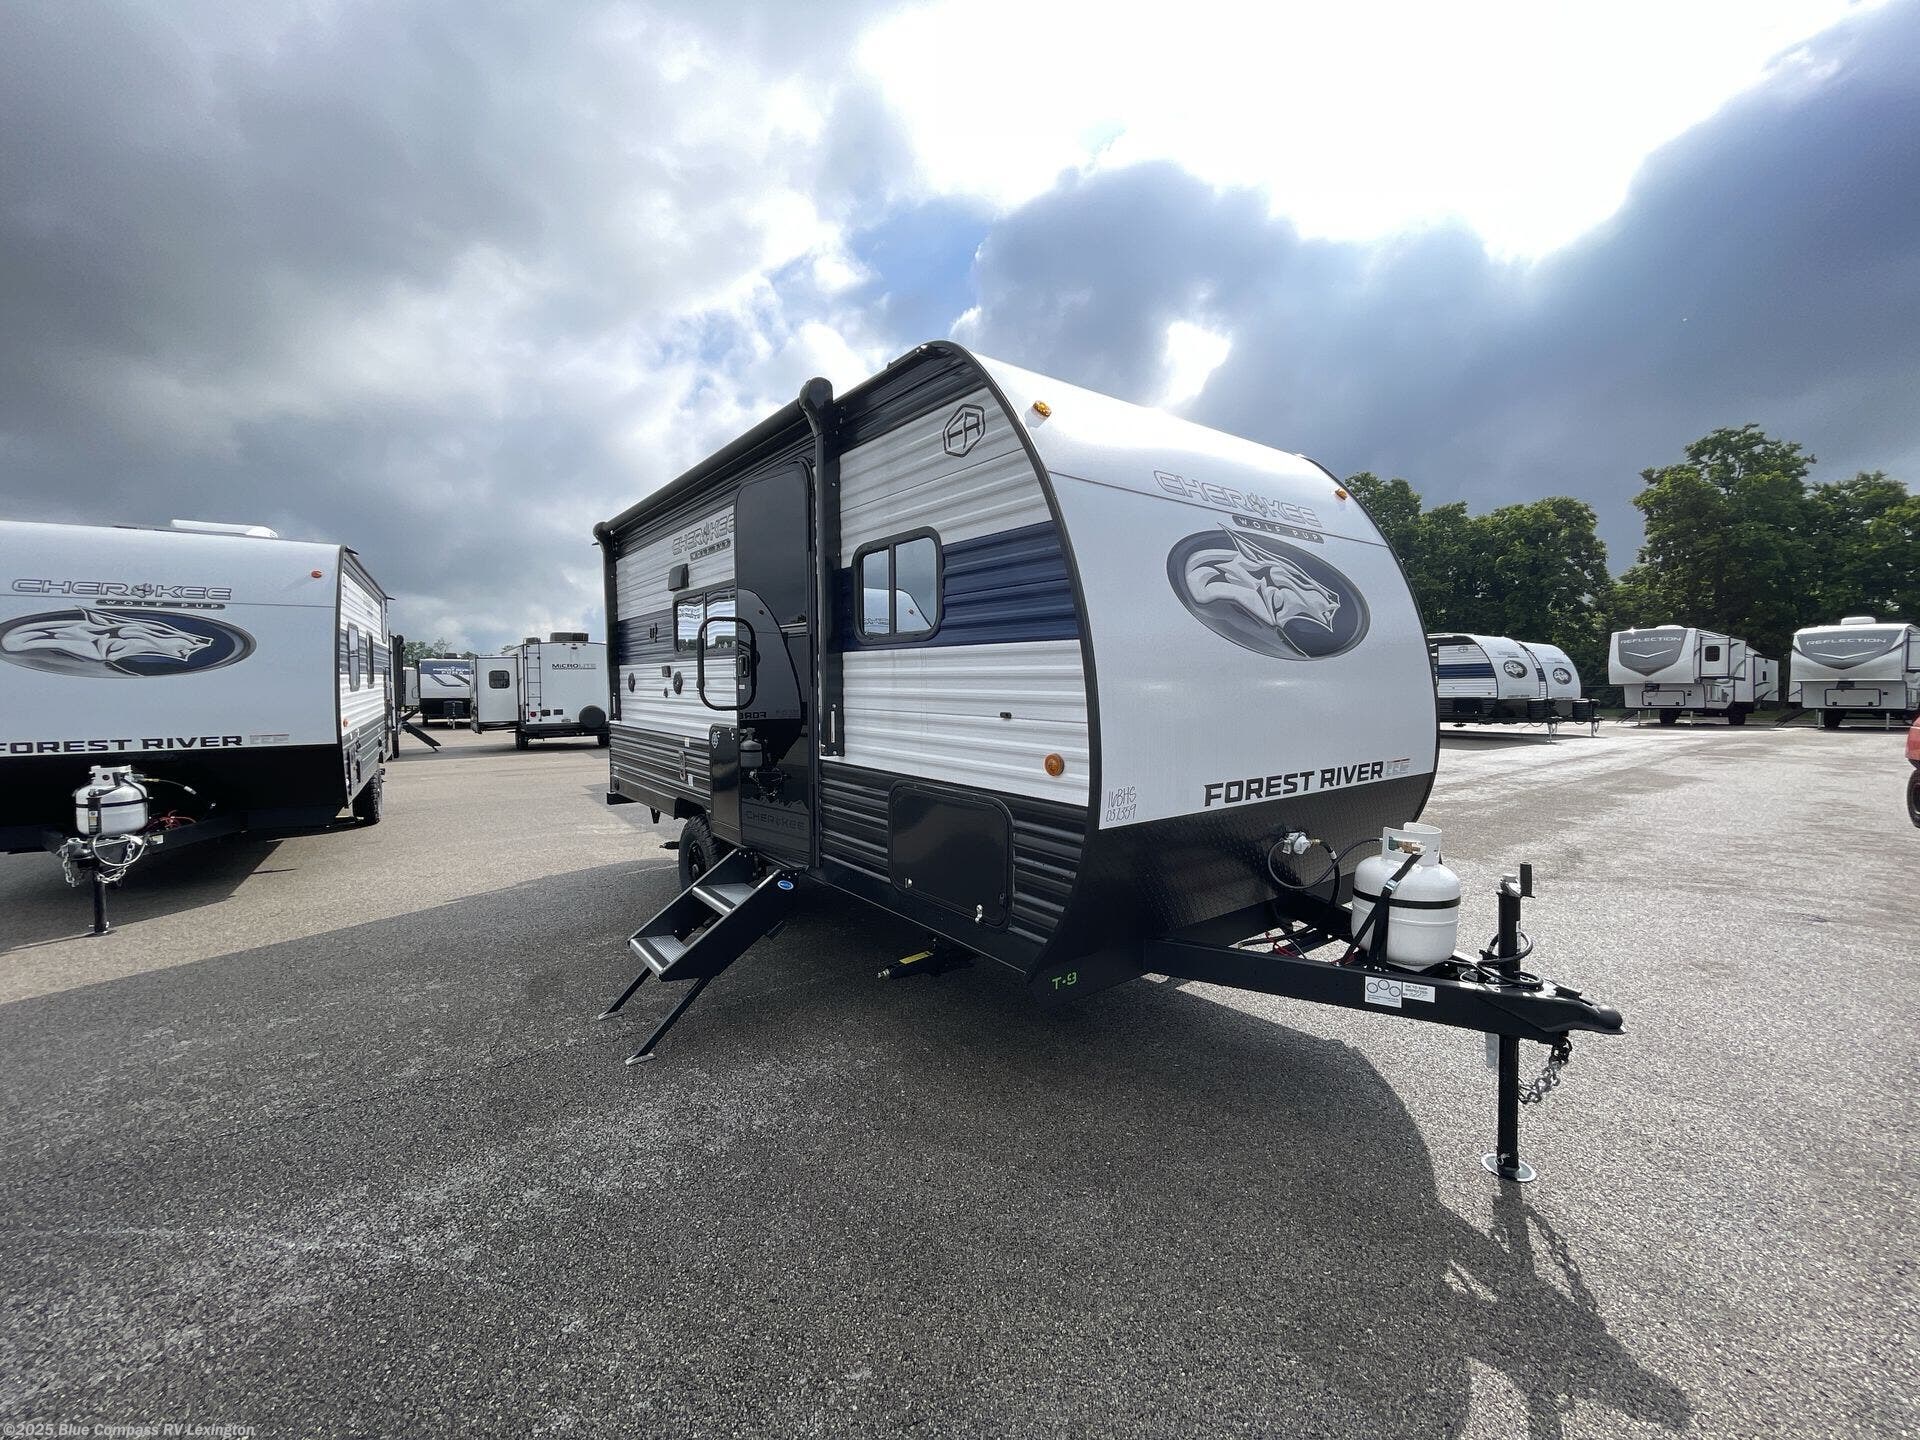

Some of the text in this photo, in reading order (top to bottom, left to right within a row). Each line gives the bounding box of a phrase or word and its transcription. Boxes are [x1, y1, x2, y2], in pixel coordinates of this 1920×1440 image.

[1153, 470, 1323, 528] CHEROKEE
[1239, 517, 1319, 541] WOLF PUP
[12, 578, 231, 600] CHEROKEE
[1620, 636, 1681, 644] REFLECTION
[142, 735, 243, 749] RIVER
[1204, 771, 1315, 807] FOREST
[1320, 761, 1384, 788] RIVER
